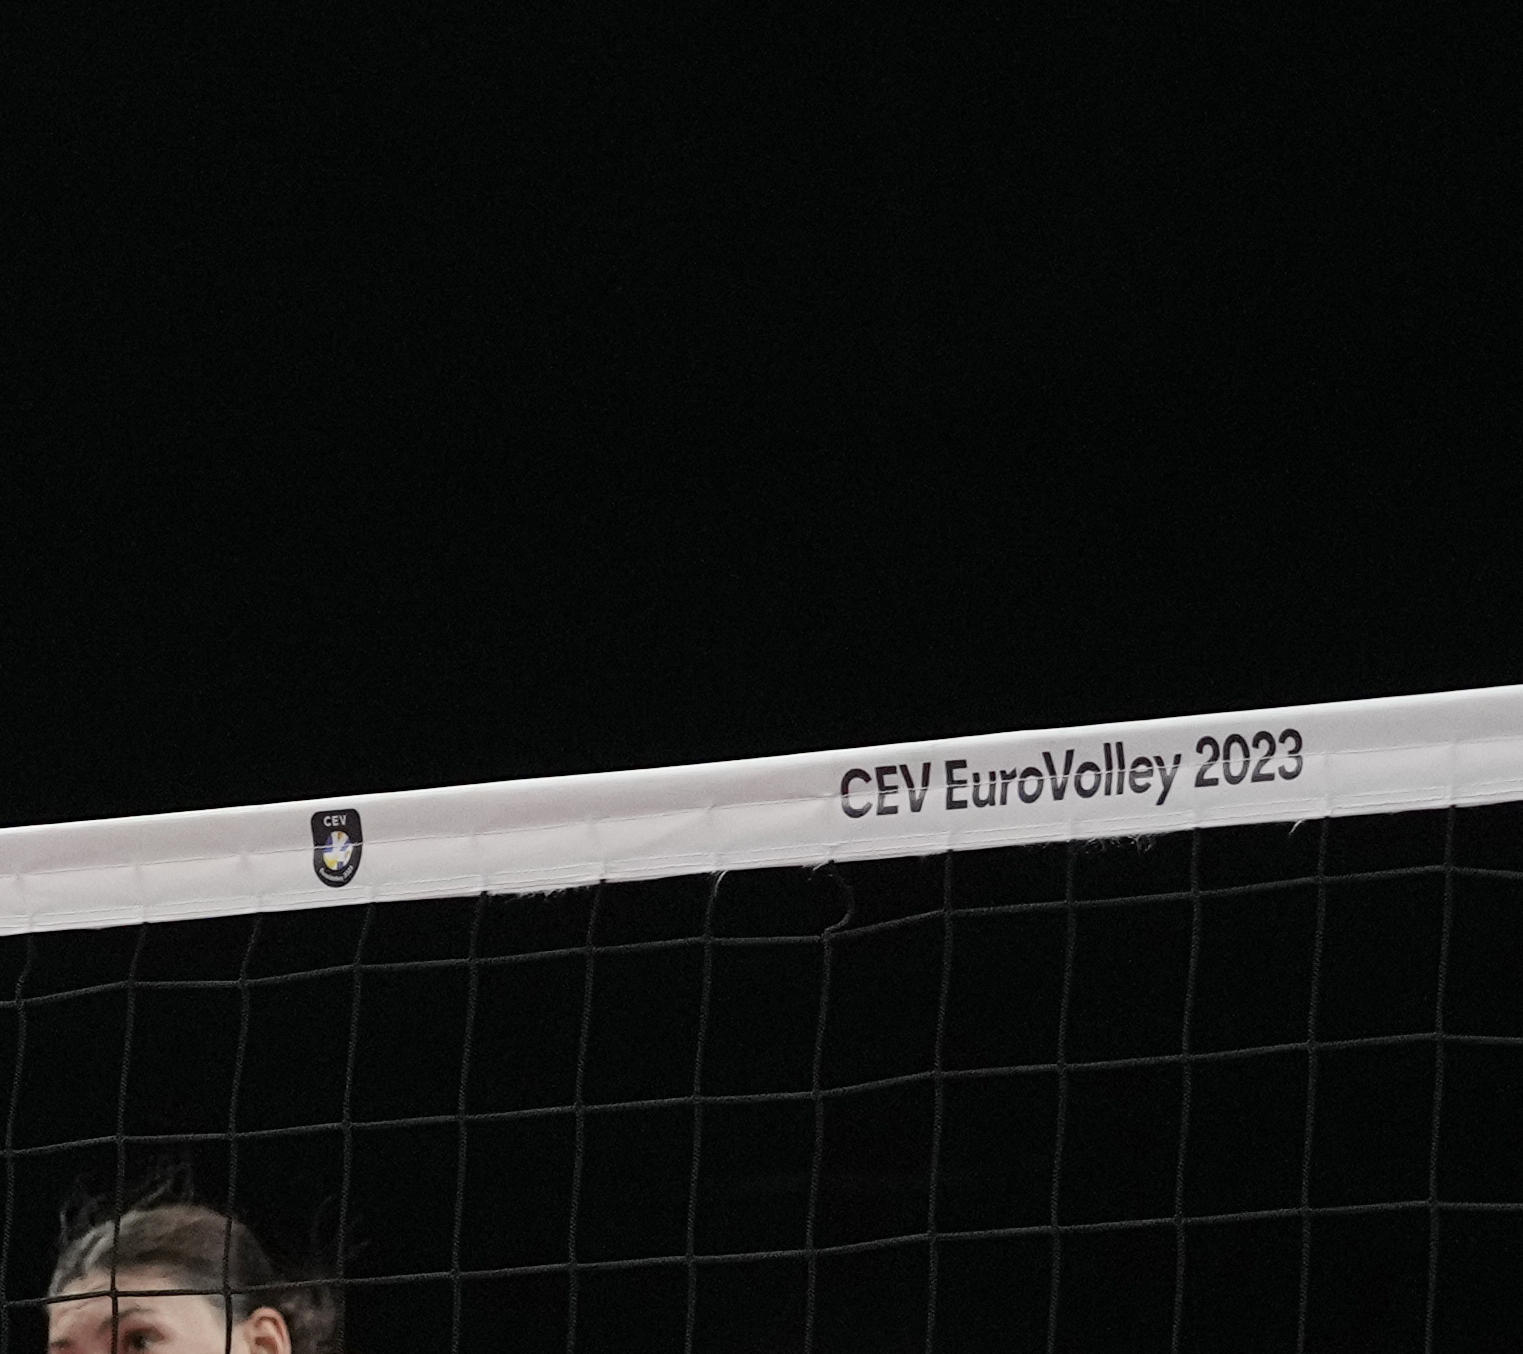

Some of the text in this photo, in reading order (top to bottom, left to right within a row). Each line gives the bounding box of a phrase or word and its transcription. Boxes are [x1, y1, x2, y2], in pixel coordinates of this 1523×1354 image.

[840, 729, 1303, 819] CEV EuroVolley 2023
[323, 814, 347, 827] CEV
